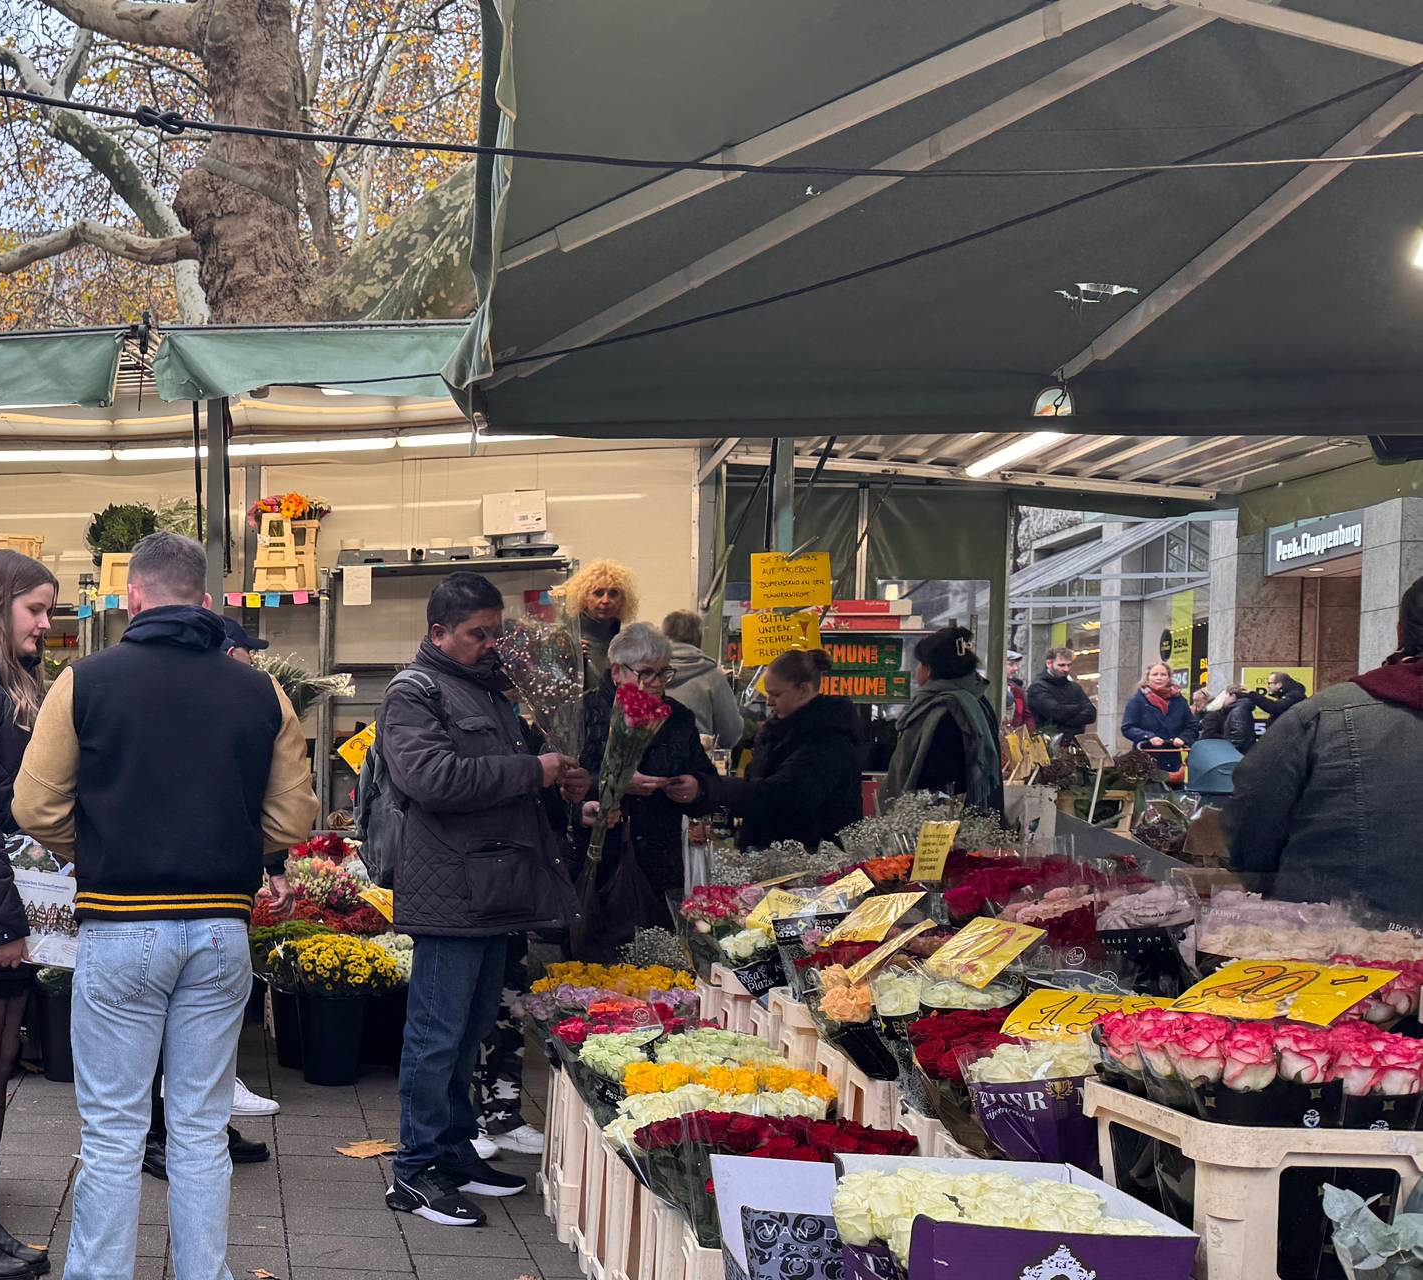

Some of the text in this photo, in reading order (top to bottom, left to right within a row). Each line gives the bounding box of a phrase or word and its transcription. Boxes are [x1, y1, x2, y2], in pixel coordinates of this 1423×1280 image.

[759, 614, 791, 624] BITTE
[758, 625, 790, 634] UNTEN
[757, 635, 793, 645] STEHEN
[763, 1222, 810, 1239] VAN
